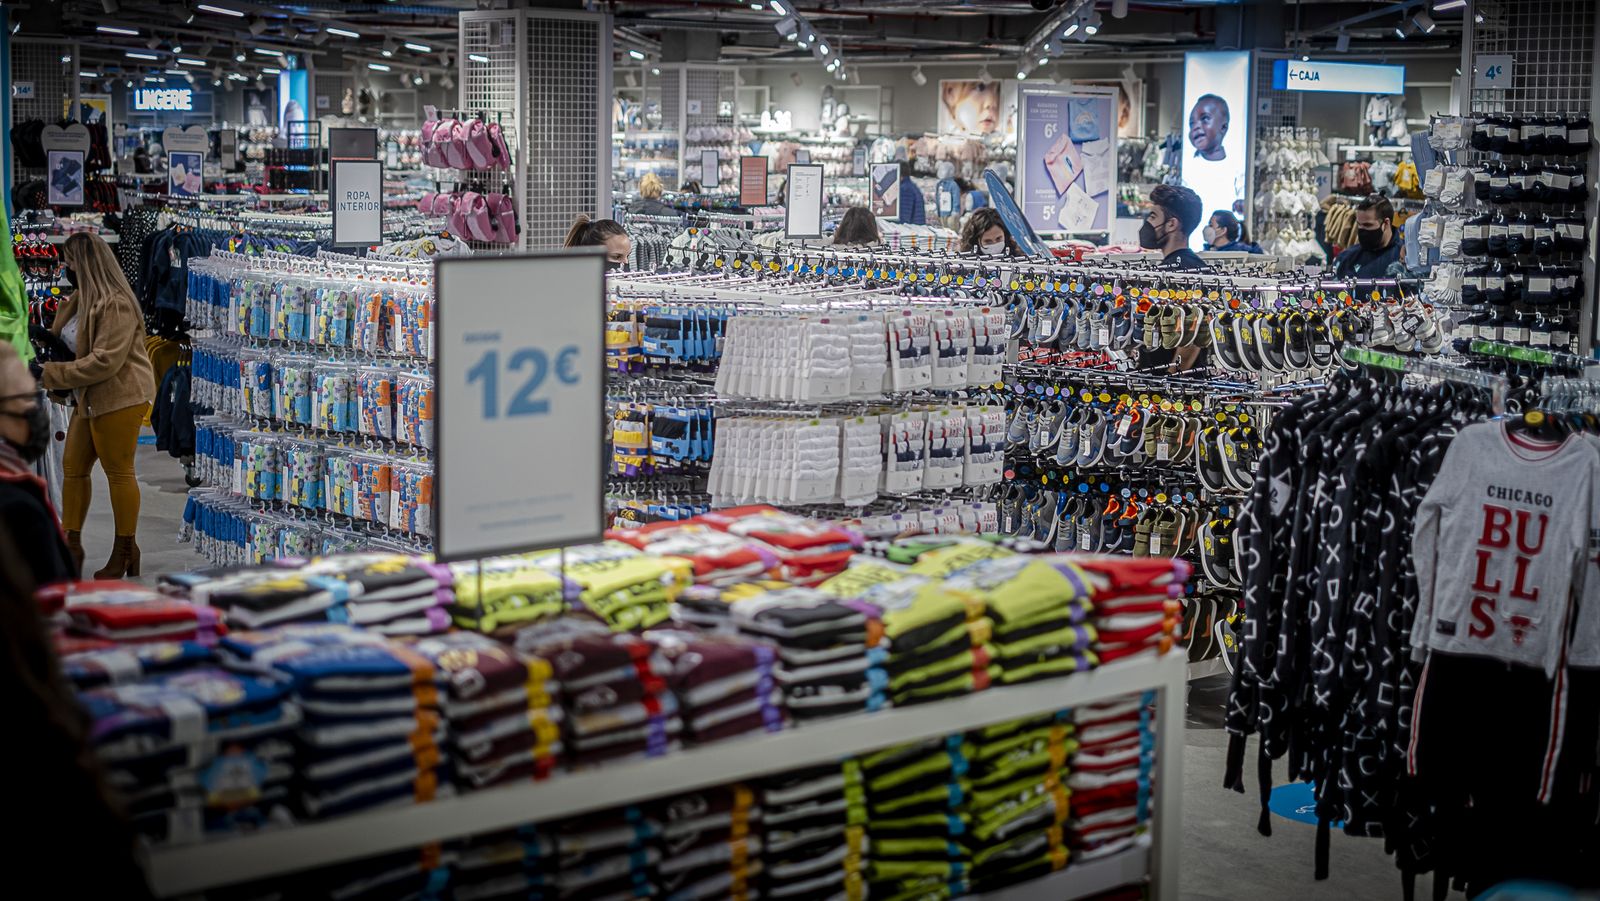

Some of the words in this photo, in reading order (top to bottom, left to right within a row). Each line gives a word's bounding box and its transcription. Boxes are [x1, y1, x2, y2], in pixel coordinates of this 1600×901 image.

[1298, 70, 1320, 81] CAJA
[1485, 64, 1502, 80] 4€
[135, 88, 192, 111] LINGERIE
[1044, 122, 1058, 138] 6€
[346, 190, 370, 201] ROPA
[337, 201, 380, 212] INTERIOR
[1043, 205, 1056, 220] 5€
[464, 343, 581, 421] 12€
[1486, 484, 1554, 508] CHICAGO
[1478, 503, 1549, 556] BU
[1471, 549, 1540, 602] LL
[1467, 595, 1497, 640] S
